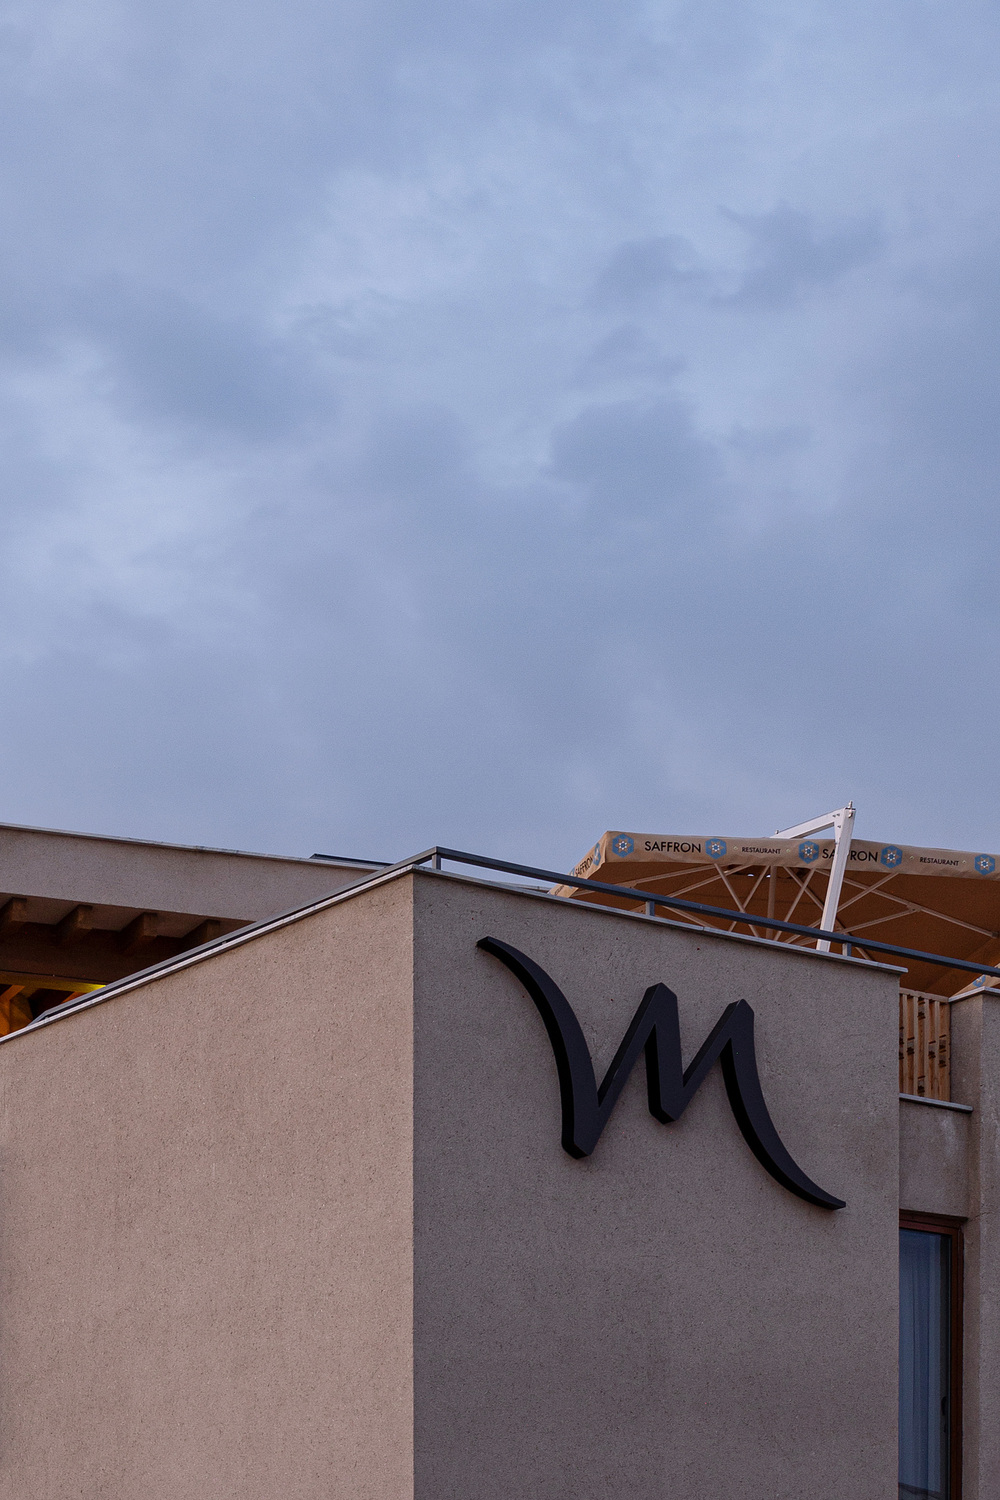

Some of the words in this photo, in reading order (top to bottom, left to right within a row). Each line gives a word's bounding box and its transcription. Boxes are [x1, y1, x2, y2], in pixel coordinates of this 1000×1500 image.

[644, 841, 701, 854] SAFFRON
[741, 846, 781, 855] RESTAURANT
[822, 849, 879, 863] SARON
[919, 856, 960, 867] RESTAURANT
